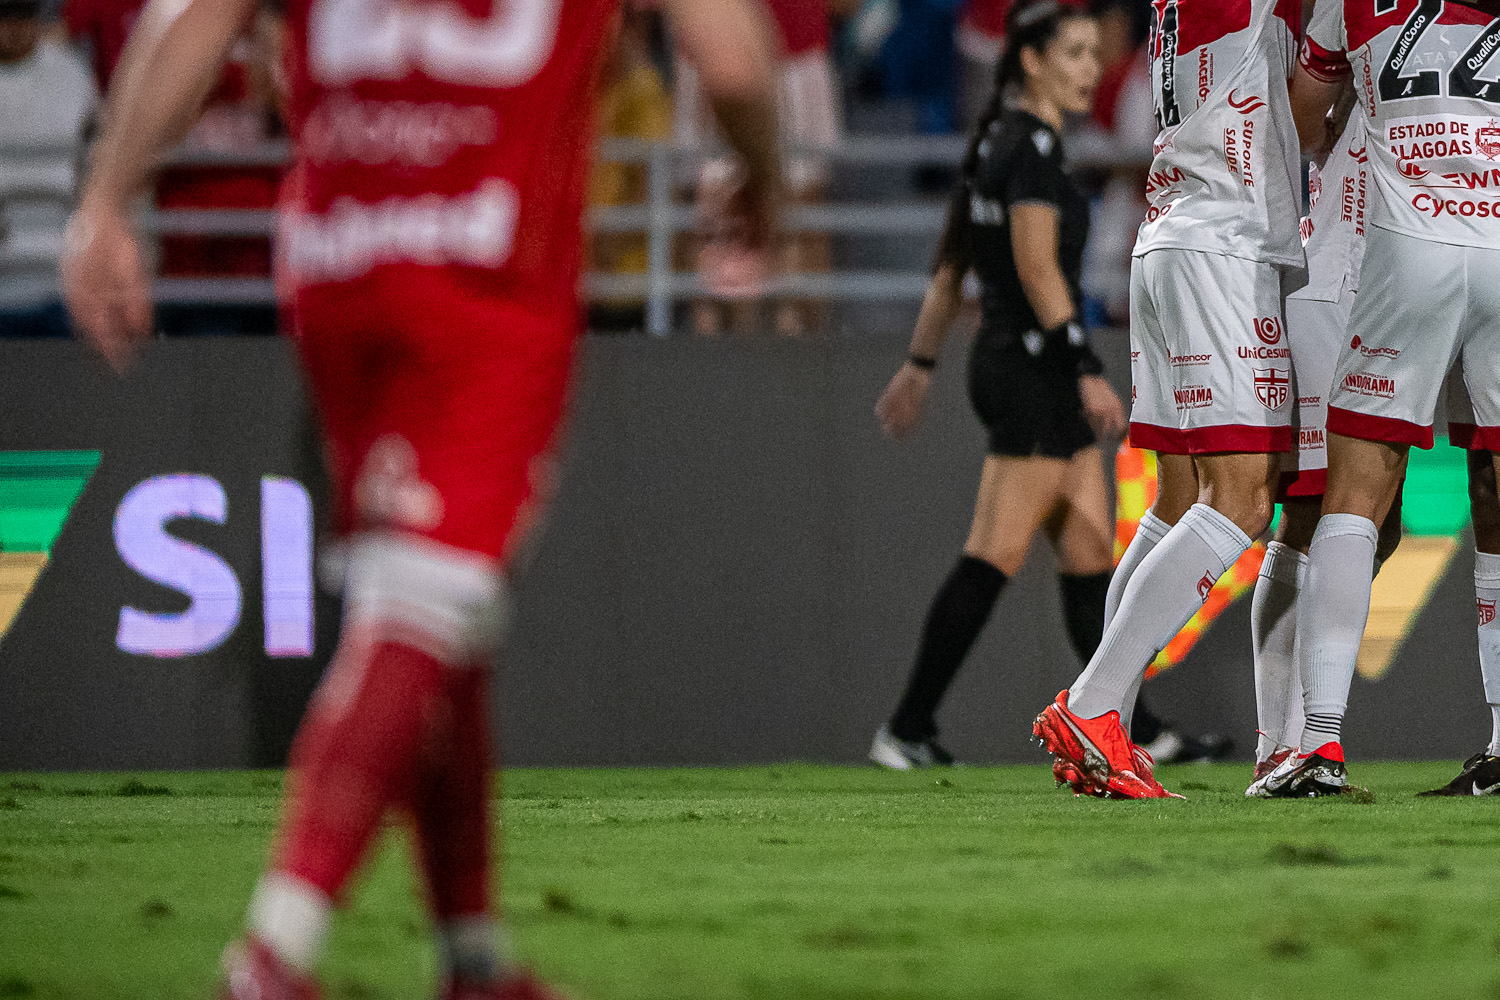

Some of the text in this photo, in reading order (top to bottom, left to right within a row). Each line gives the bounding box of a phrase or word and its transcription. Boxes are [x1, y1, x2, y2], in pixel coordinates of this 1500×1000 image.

[1391, 15, 1426, 70] QualiCoco
[1225, 127, 1238, 174] SAÚDE
[1242, 120, 1255, 187] SUPORTE
[1389, 121, 1469, 140] ESTADO DE
[1343, 177, 1355, 222] SAÚDE
[1355, 170, 1367, 237] SUPORTE
